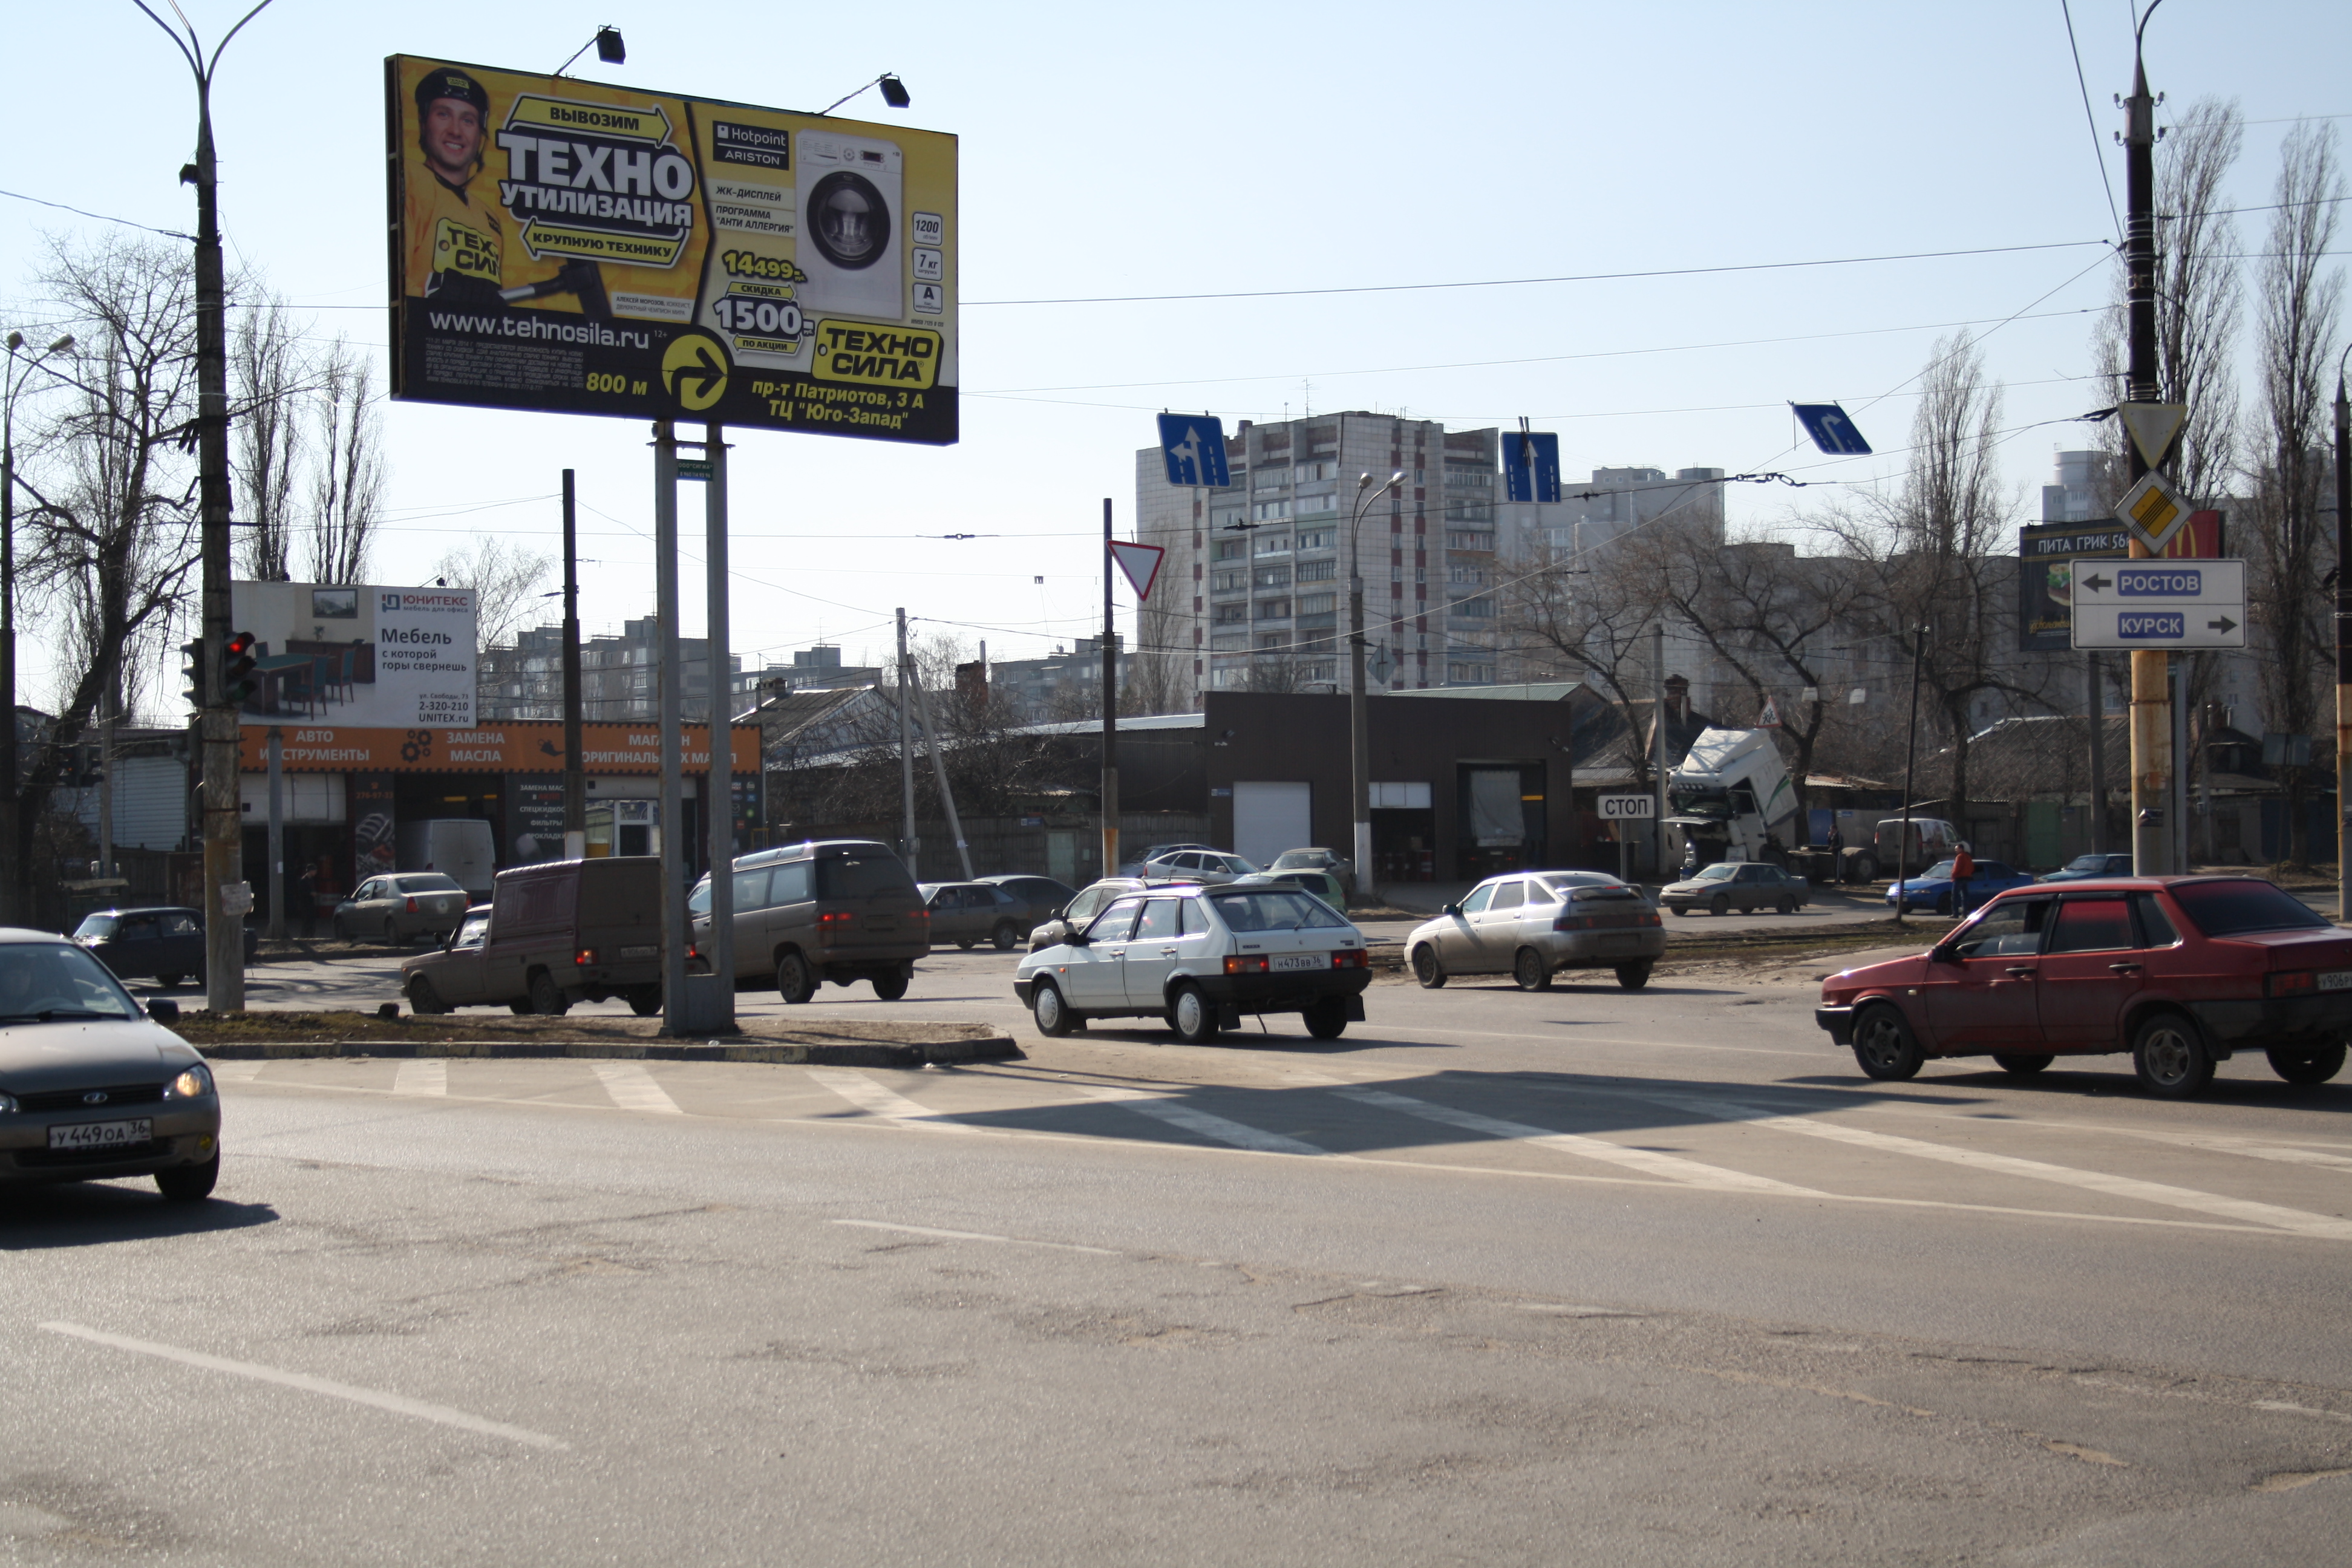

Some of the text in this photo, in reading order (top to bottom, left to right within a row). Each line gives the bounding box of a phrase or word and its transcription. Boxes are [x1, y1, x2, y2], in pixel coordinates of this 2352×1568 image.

[550, 106, 639, 131] ВЫВОЗИМ
[731, 128, 786, 147] Hotpoint
[498, 132, 693, 200] ТЕХНО
[725, 150, 780, 166] ARISTON
[716, 186, 782, 202] ЖК-ДИСПЛЕЙ
[500, 182, 692, 227] УТИЛИЗАЦИЯ
[716, 206, 771, 220] ПРОГРАММА
[916, 220, 939, 233] 1200
[447, 226, 498, 261] ТЕХ
[533, 232, 672, 258] КРУПНУЮ ТЕХНИКУ
[920, 254, 938, 269] 7 кг
[741, 284, 782, 297] СКИДКА
[429, 312, 650, 350] www.tehnosila.ru
[654, 330, 668, 339] 12+
[742, 339, 788, 351] ПО АКЦИИ
[826, 327, 933, 359] ТЕХНО
[832, 352, 922, 382] СИЛА
[586, 373, 648, 396] 800 м
[752, 380, 790, 398] пр-т
[795, 382, 892, 408] Патриотов,
[896, 392, 907, 407] 3
[769, 399, 909, 430] ТЦ "Юго-Запад"
[2038, 538, 2071, 554] ПИТА
[2076, 535, 2108, 550] ГРИК
[2120, 575, 2199, 592] РОСТОВ
[403, 595, 468, 606] ЮНИТЕКС
[2121, 618, 2181, 633] КУРСК
[382, 628, 452, 645] Мебель
[391, 649, 437, 661] которой
[383, 662, 467, 672] горы свернешь
[419, 701, 468, 711] 2-320-210
[419, 713, 469, 724] UNITEX.ru
[295, 730, 334, 742] АВТО
[446, 731, 506, 744] ЗАМЕНА
[629, 734, 690, 746] МАГН
[260, 748, 370, 761] ИСТРУМЕНТЫ
[450, 750, 502, 762] МАСЛА
[582, 751, 688, 763] ОРИГИНАЛЬХ
[1605, 799, 1648, 815] СТОП
[57, 1121, 145, 1146] У449ОА 36
